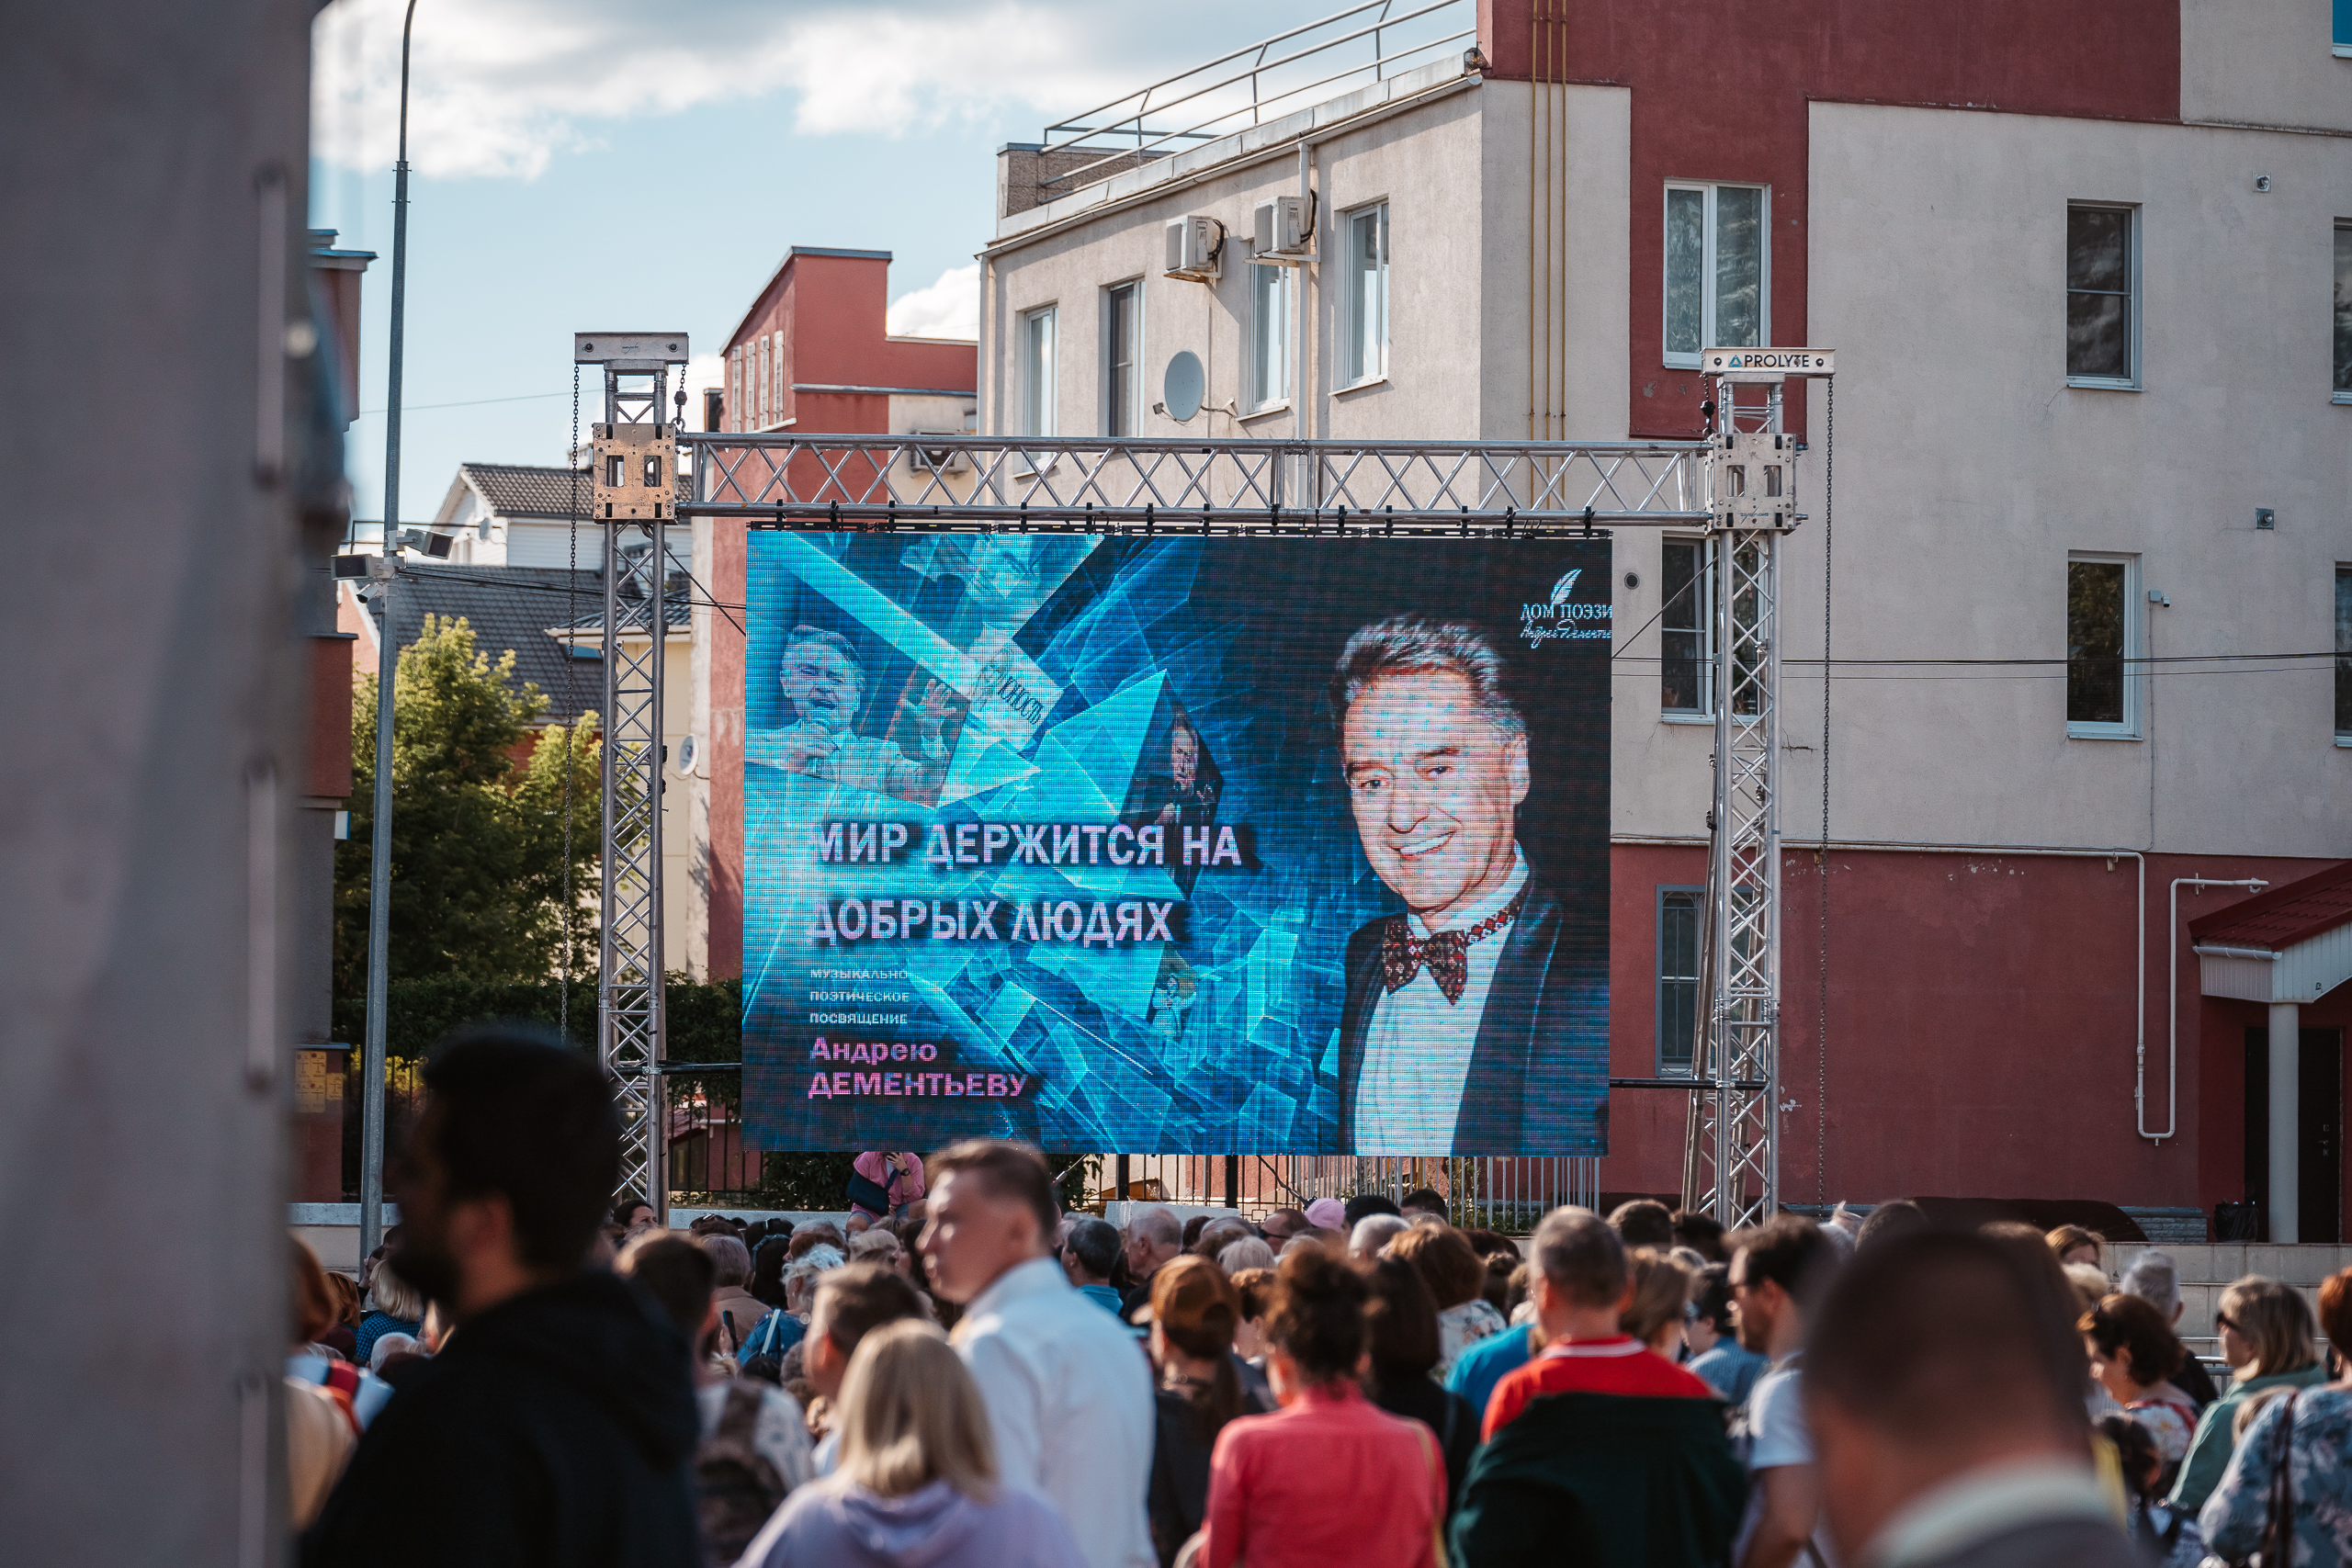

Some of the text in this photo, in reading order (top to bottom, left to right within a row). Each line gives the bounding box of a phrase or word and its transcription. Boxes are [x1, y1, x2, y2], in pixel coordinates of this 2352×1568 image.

[1745, 355, 1809, 367] PROLYTE
[1521, 603, 1555, 620] ДОМ
[810, 822, 1242, 871] МИР ДЕРЖИТСЯ НА
[807, 898, 1175, 948] ДОБРЫХ ЛЮДЯХ
[809, 991, 910, 1002] ПОЭТИЧЕСКОЕ
[809, 1012, 908, 1025] ПОСВЯЩЕНИЕ
[809, 1036, 938, 1066] Андрею
[808, 1072, 1029, 1100] ДЕМЕНТЬЕВУ
